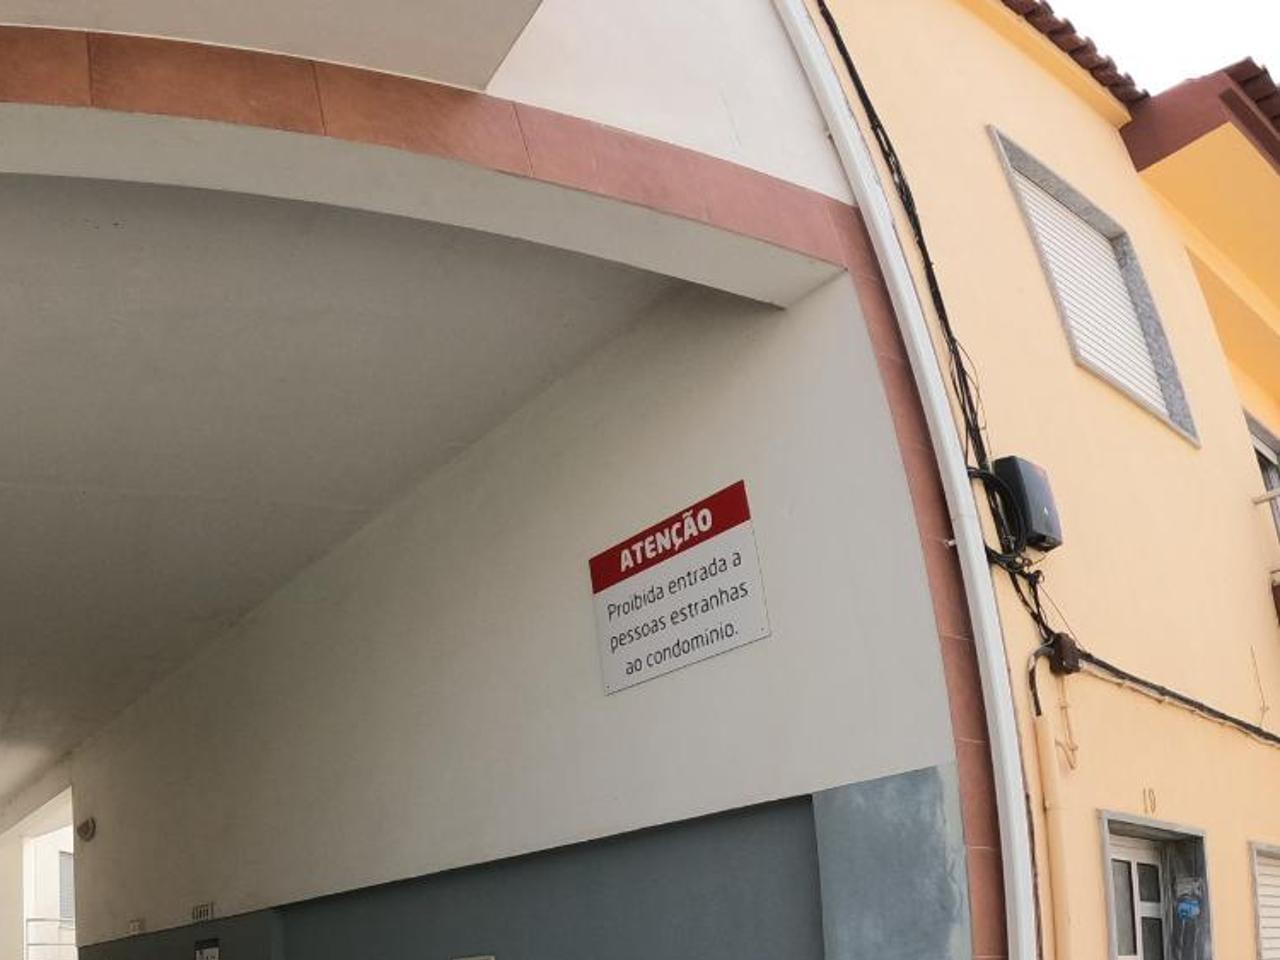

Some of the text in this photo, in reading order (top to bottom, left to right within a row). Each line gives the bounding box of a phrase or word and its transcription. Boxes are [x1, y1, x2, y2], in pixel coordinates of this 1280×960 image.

[620, 508, 713, 573] ATENÇÃO
[606, 552, 742, 622] Proibida entrada a
[610, 581, 749, 654] pessoas estranhas
[625, 622, 739, 675] ao condomínio.
